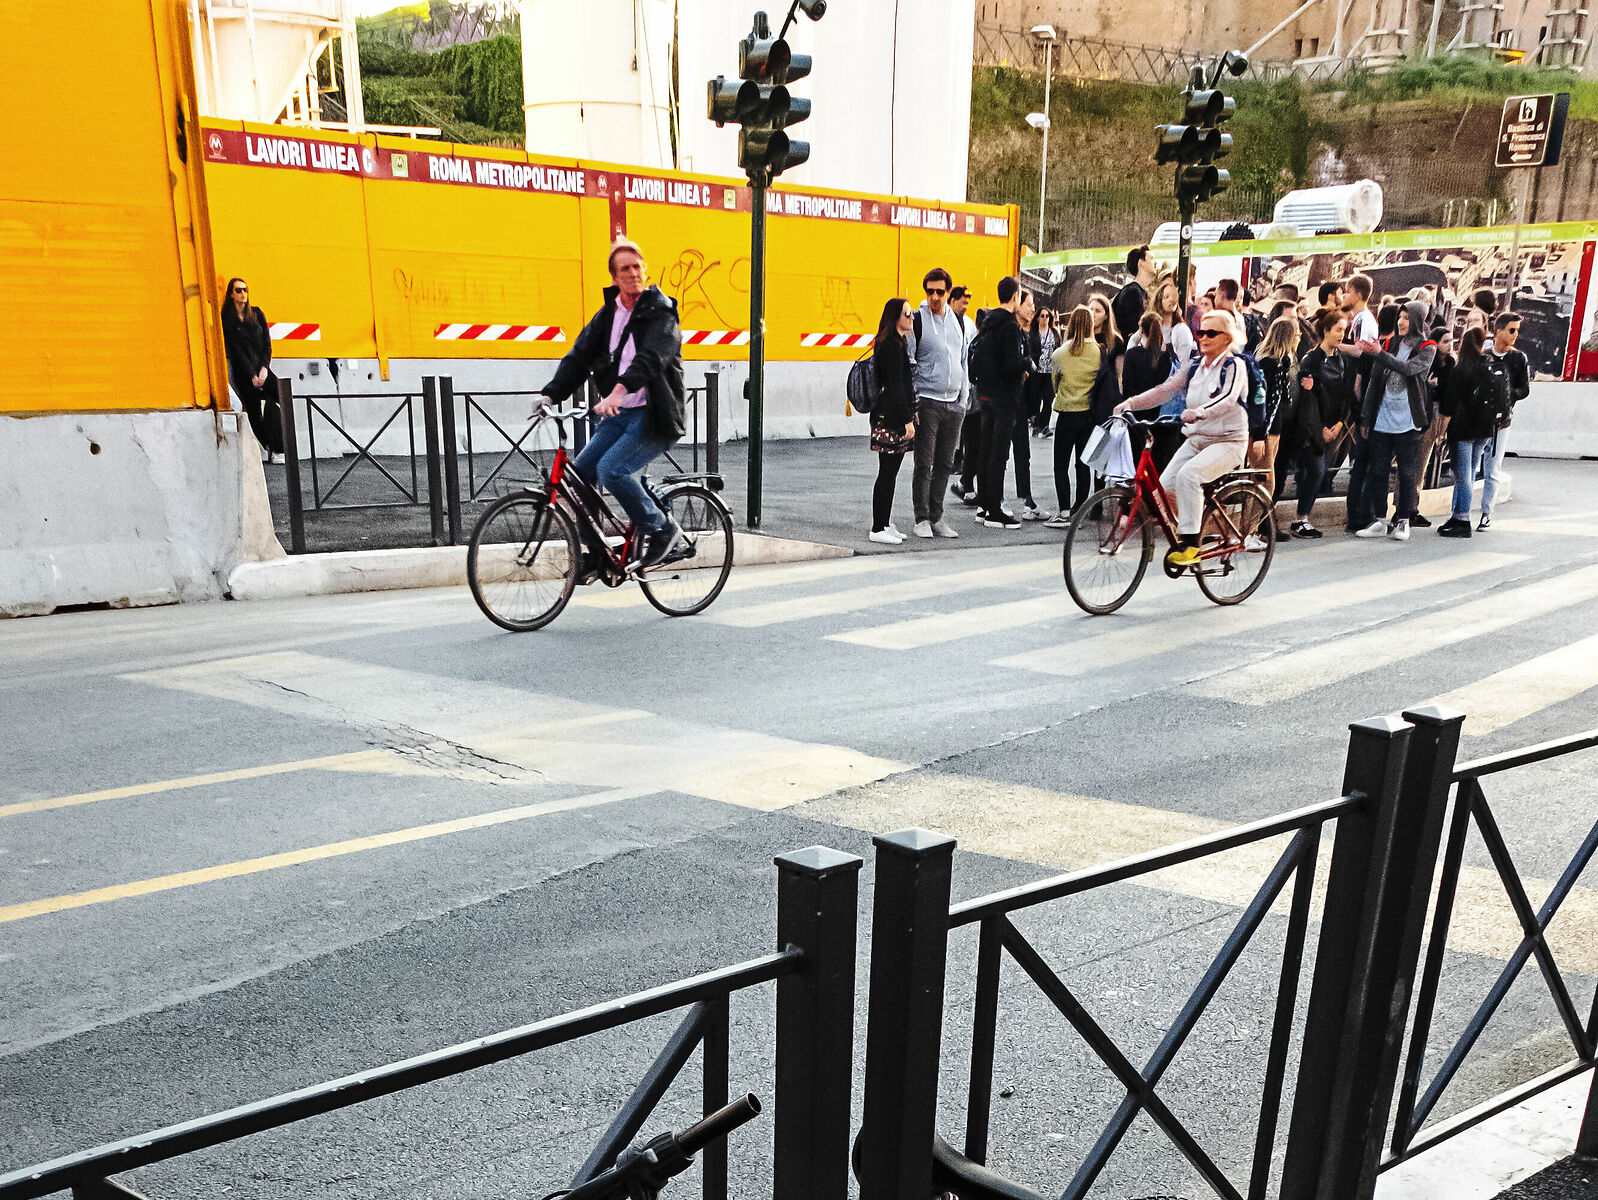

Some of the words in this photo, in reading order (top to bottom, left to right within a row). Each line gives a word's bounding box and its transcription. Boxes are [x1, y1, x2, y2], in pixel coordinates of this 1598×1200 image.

[245, 136, 306, 166] LAVORI
[311, 143, 360, 172] LINEA
[362, 149, 373, 173] C
[428, 156, 473, 183] ROMA
[476, 162, 585, 193] METROPOLITANE
[624, 175, 666, 201] LAVORI
[668, 180, 701, 205] LINEA
[702, 186, 711, 207] C
[784, 194, 862, 220] METROPOLITANE
[891, 205, 921, 227] LAVORI
[922, 209, 947, 230] LINEA
[949, 212, 956, 231] C
[985, 217, 1009, 236] ROMA
